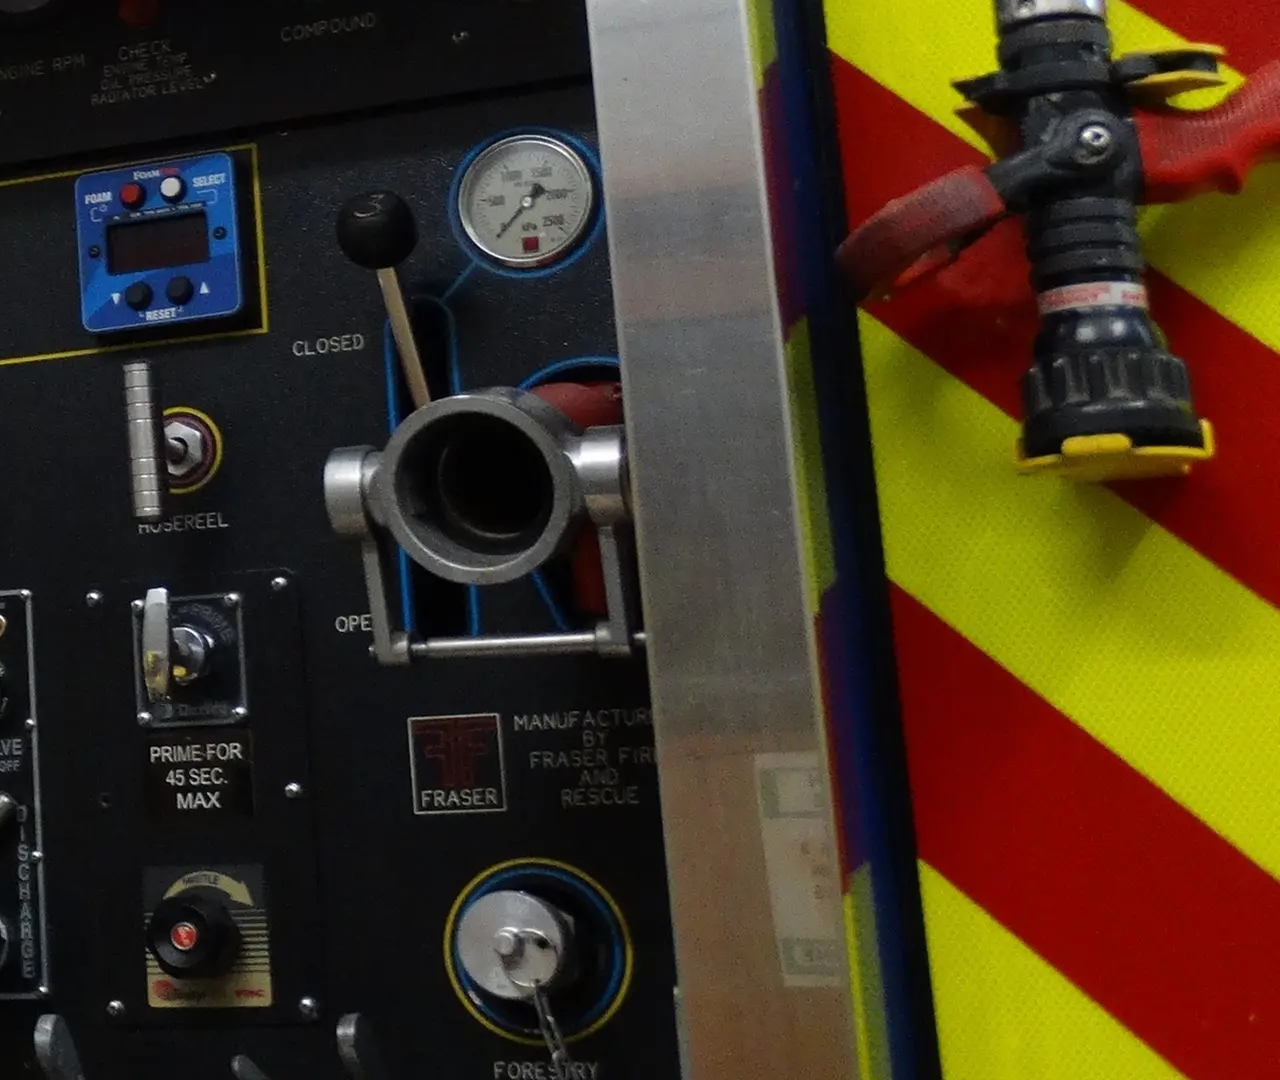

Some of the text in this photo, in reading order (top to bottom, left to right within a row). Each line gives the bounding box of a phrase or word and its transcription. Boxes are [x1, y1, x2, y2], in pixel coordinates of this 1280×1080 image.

[280, 12, 377, 42] COMPOUND
[118, 38, 172, 62] CHECK
[156, 51, 188, 67] TEMP
[52, 53, 86, 71] RPM
[100, 63, 192, 91] OIL PRESSURE
[91, 77, 203, 106] RADIATOR LEVEL
[192, 173, 227, 187] SELECT
[84, 191, 113, 205] FOAM
[353, 194, 385, 218] 3
[145, 308, 177, 321] RESET
[292, 333, 365, 357] CLOSED
[138, 511, 229, 534] HOSEREEL
[335, 614, 373, 633] OPE
[513, 707, 652, 732] MANUFACTUR
[582, 730, 608, 748] BY
[149, 742, 242, 764] PRIME FOR
[529, 746, 655, 770] FRASER FIR
[165, 767, 228, 787] 45 SEC.
[578, 768, 620, 786] AND
[176, 792, 222, 809] MAX
[421, 788, 498, 808] FRASER
[560, 786, 640, 809] RESCUE
[16, 805, 35, 979] DISCHARGE
